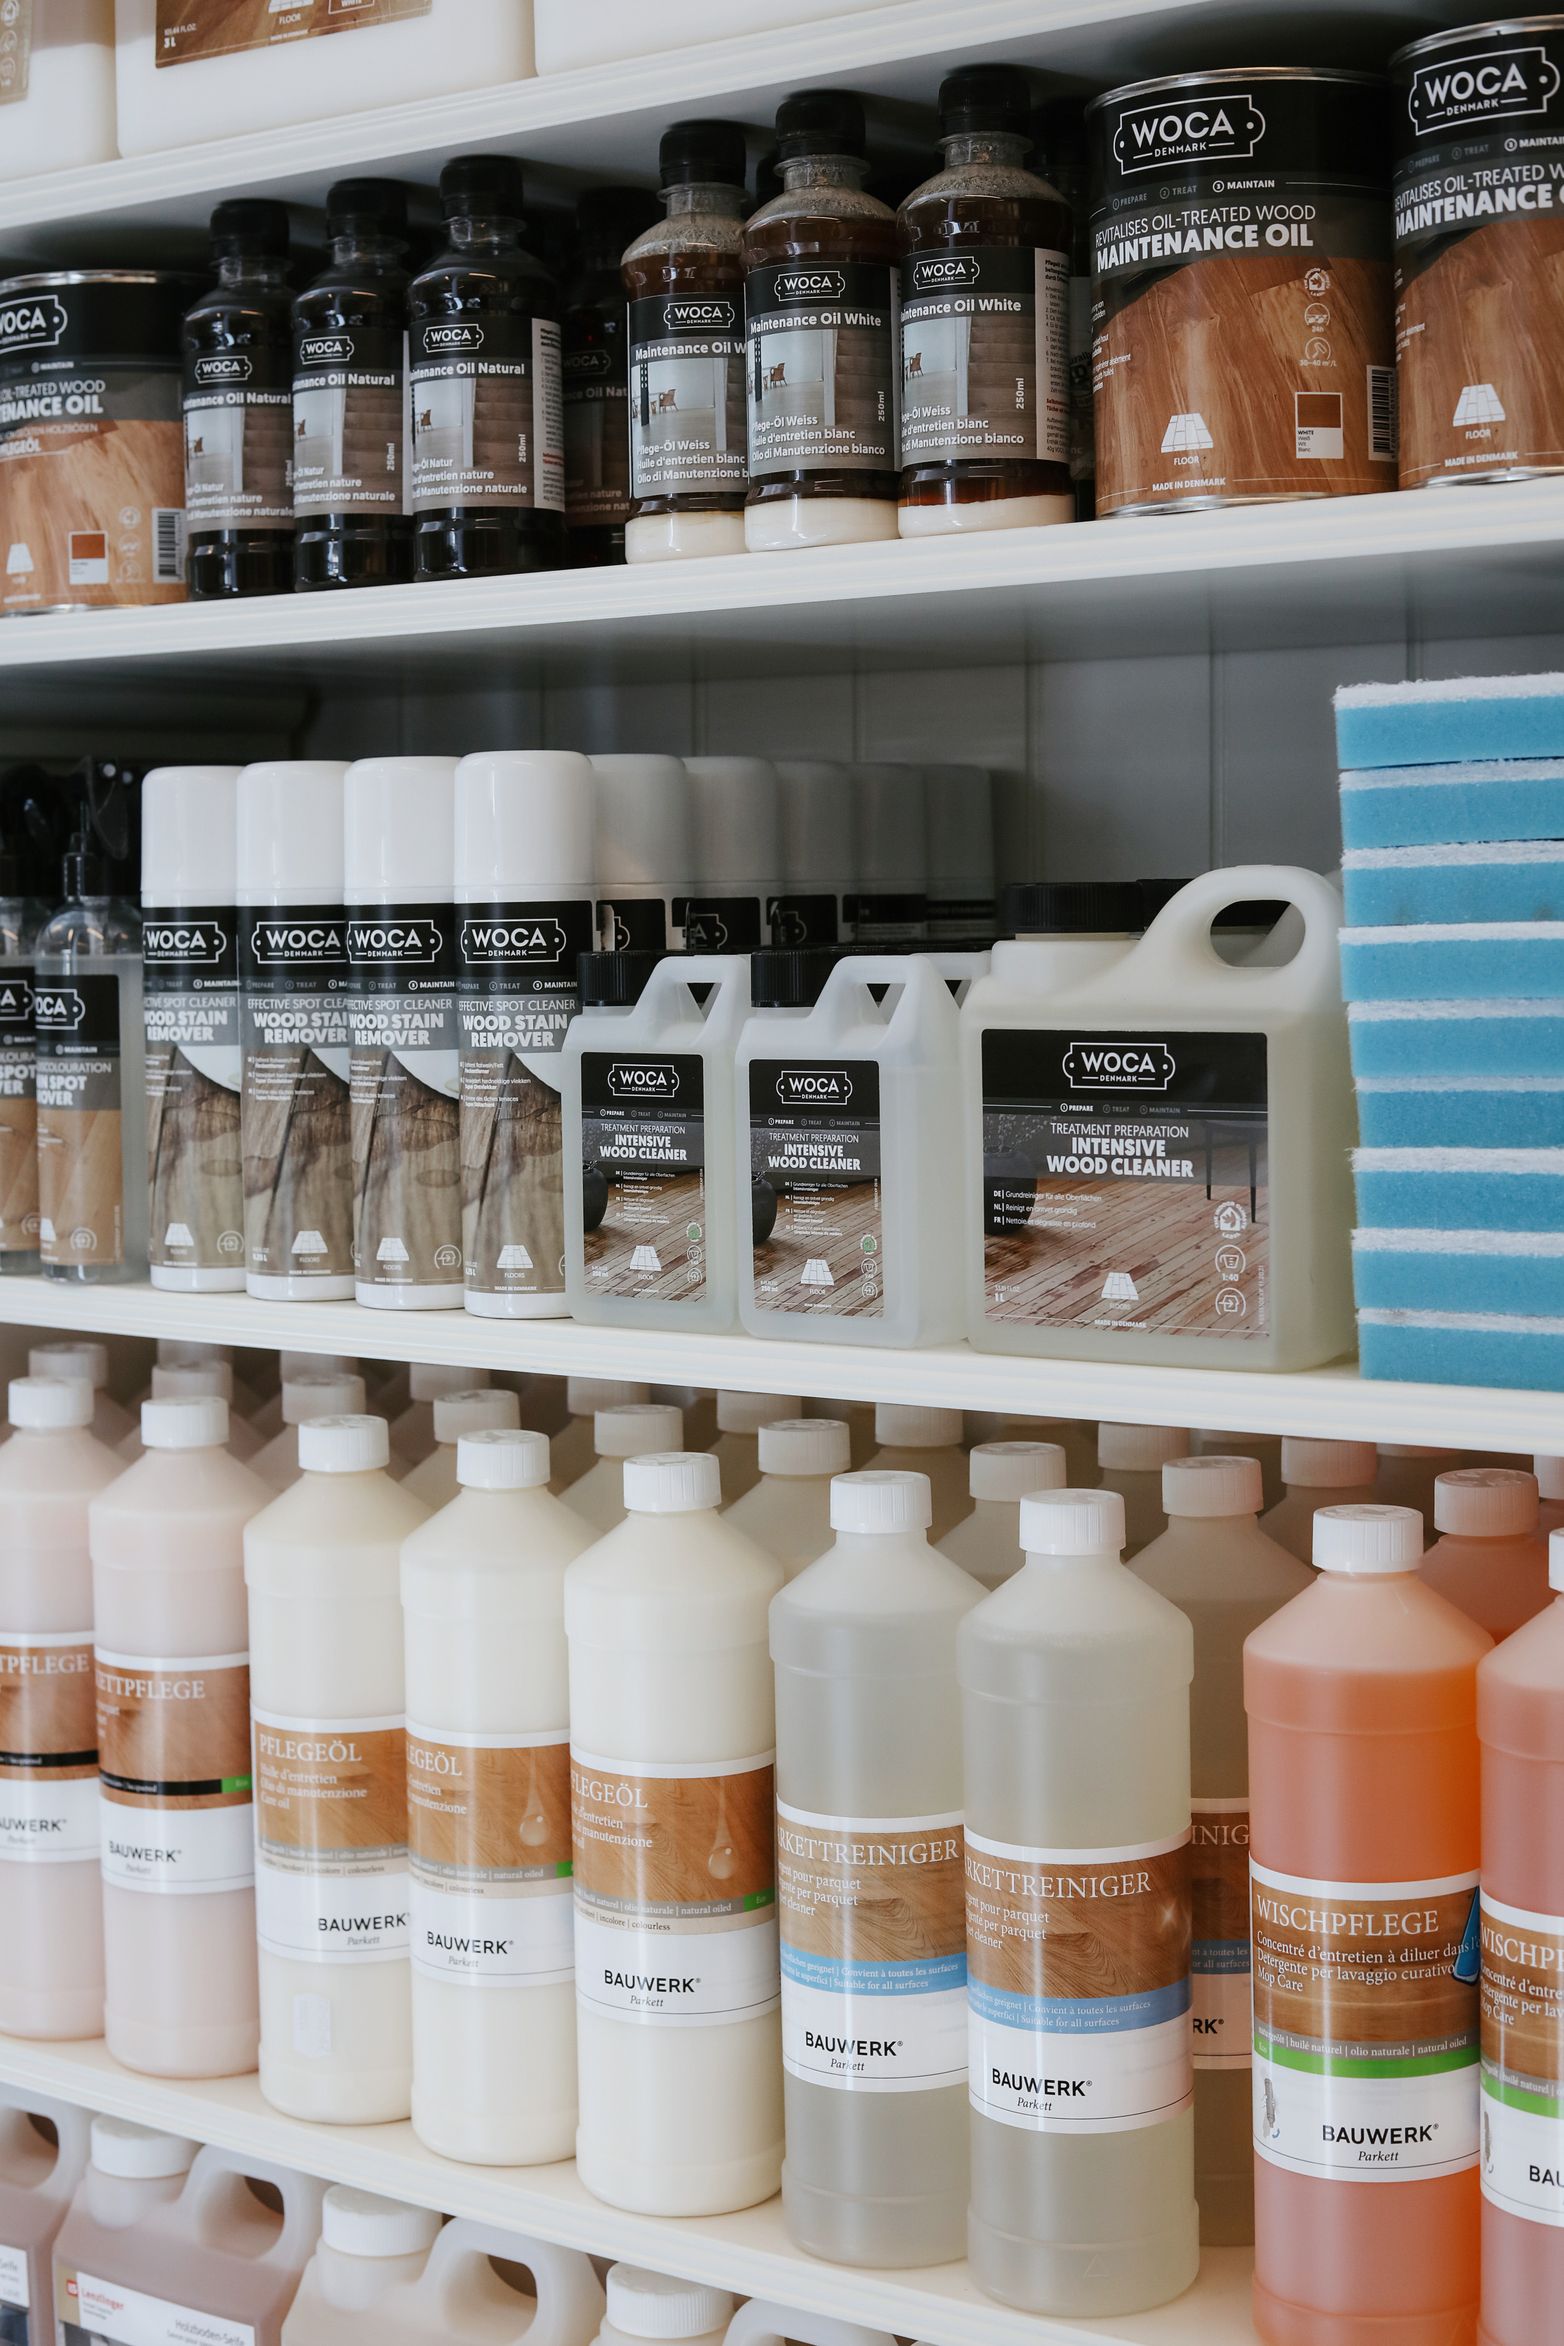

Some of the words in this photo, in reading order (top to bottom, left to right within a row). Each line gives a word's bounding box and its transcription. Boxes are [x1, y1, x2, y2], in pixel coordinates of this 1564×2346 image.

[1424, 62, 1528, 107] WOCA
[1446, 98, 1499, 116] DENMARK
[1131, 108, 1235, 148] WOCA
[1154, 142, 1207, 157] DENMARK
[1444, 164, 1545, 195] OIL-TREATED
[1172, 185, 1198, 196] TREAT
[1226, 180, 1275, 190] MAINTAIN
[1151, 206, 1251, 232] OIL-TREATED
[1255, 204, 1316, 221] WOOD
[1396, 183, 1554, 240] MAINTENANCE
[1097, 224, 1259, 274] MAINTENANCE
[1265, 223, 1314, 247] OIL
[922, 262, 966, 278] WOCA
[784, 276, 833, 291] WOCA
[675, 307, 723, 320] WOCA
[954, 299, 975, 313] Oil
[979, 299, 1022, 312] White
[750, 315, 817, 335] Maintenance
[820, 312, 841, 325] Oil
[845, 313, 882, 327] White
[431, 328, 471, 342] WOCA
[306, 341, 342, 354] WOCA
[635, 344, 709, 361] Maintenance
[711, 342, 731, 354] Oil
[202, 360, 240, 374] WOCA
[456, 363, 475, 374] Oil
[478, 363, 525, 375] Natural
[59, 380, 106, 395] WOOD
[328, 373, 346, 386] Oil
[348, 373, 395, 387] Natural
[226, 392, 244, 405] Oil
[247, 393, 292, 405] Natural
[1016, 377, 1025, 410] 250ml
[65, 394, 104, 415] OIL
[877, 391, 886, 422] 250ml
[922, 406, 951, 417] Weiss
[787, 414, 819, 426] Weiss
[956, 419, 989, 429] blanc
[824, 427, 855, 439] blanc
[984, 432, 1024, 445] bianco
[1465, 429, 1491, 440] FLOOR
[518, 434, 527, 463] 250ml
[678, 440, 711, 451] Weiss
[773, 441, 850, 458] Manutenzione
[852, 440, 886, 455] bianco
[387, 442, 395, 471] 250ml
[656, 455, 714, 467] d'entretien
[716, 452, 746, 463] blanc
[1173, 456, 1200, 466] FLOOR
[460, 470, 495, 481] nature
[664, 468, 741, 482] Manutenzione
[485, 483, 528, 495] naturale
[1152, 483, 1174, 492] MADE
[1184, 477, 1226, 490] DENMARK
[147, 930, 207, 949] WOCA
[266, 929, 341, 948] WOCA
[354, 928, 422, 948] WOCA
[472, 928, 547, 947] WOCA
[189, 997, 236, 1009] CLEANER
[294, 999, 320, 1010] SPOT
[375, 1000, 400, 1011] SPOT
[404, 999, 452, 1011] CLEANER
[497, 1000, 525, 1011] SPOT
[528, 1000, 576, 1011] CLEANER
[179, 1011, 228, 1026] STAIN
[253, 1013, 307, 1028] WOOD
[350, 1014, 389, 1030] WOOD
[392, 1013, 444, 1029] STAIN
[463, 1015, 511, 1031] WOOD
[515, 1014, 568, 1030] STAIN
[147, 1026, 214, 1042] REMOVER
[264, 1028, 348, 1043] REMOVER
[355, 1030, 430, 1046] REMOVER
[472, 1031, 555, 1048] REMOVER
[1081, 1051, 1156, 1074] WOCA
[620, 1070, 668, 1086] WOCA
[789, 1077, 840, 1093] WOCA
[1100, 1075, 1138, 1083] DENMARK
[1068, 1104, 1094, 1113] PREPARE
[601, 1122, 639, 1133] TREATMENT
[640, 1125, 686, 1135] PREPARATION
[1050, 1122, 1112, 1137] TREATMENT
[1114, 1124, 1189, 1139] PREPARATION
[615, 1134, 671, 1148] INTENSIVE
[769, 1132, 810, 1142] TREATMENT
[811, 1133, 859, 1144] PREPARATION
[600, 1145, 637, 1159] WOOD
[639, 1147, 688, 1161] CLEANER
[784, 1143, 844, 1157] INTENSIVE
[1071, 1137, 1166, 1158] INTENSIVE
[768, 1155, 807, 1169] WOOD
[809, 1157, 861, 1171] CLEANER
[1046, 1155, 1108, 1175] WOOD
[1111, 1159, 1195, 1178] CLEANER
[259, 1733, 362, 1762] PFLEGEÖL
[494, 1869, 523, 1880] natural
[525, 1868, 544, 1879] oiled
[816, 1875, 861, 1891] parquet
[814, 1891, 858, 1908] parquet
[681, 1905, 710, 1915] natural
[712, 1903, 732, 1913] oiled
[980, 1901, 1001, 1915] pour
[1003, 1907, 1049, 1925] parquet
[1256, 1894, 1439, 1936] WISCHPFLEGE
[632, 1918, 671, 1931] colourless
[1001, 1924, 1046, 1941] parquet
[1257, 1931, 1304, 1957] Concentré
[1387, 1950, 1395, 1963] à
[1400, 1946, 1440, 1964] diluer
[1443, 1942, 1469, 1957] dans
[888, 1966, 914, 1977] toutes
[928, 1962, 960, 1974] surfaces
[1257, 1948, 1308, 1976] Detergente
[1311, 1964, 1332, 1981] per
[1337, 1964, 1397, 1985] lavaggio
[1401, 1963, 1455, 1981] curativo
[895, 1978, 929, 1989] surfaces
[1257, 1964, 1275, 1988] Mop
[1277, 1973, 1303, 1992] Care
[1076, 2003, 1104, 2015] toutes
[1105, 2003, 1117, 2014] les
[1118, 1999, 1151, 2012] surfaces
[1493, 2004, 1515, 2026] Care
[1521, 2001, 1542, 2016] per
[1085, 2015, 1120, 2027] surfaces
[1290, 2037, 1310, 2050] huilé
[1312, 2043, 1343, 2055] naturel
[1350, 2045, 1369, 2056] olio
[1371, 2045, 1410, 2057] naturale
[1417, 2040, 1448, 2054] natural
[1449, 2036, 1467, 2050] oiled
[831, 2057, 865, 2072] Parkett
[1520, 2078, 1549, 2094] naturel
[1017, 2096, 1052, 2112] Parkett
[1358, 2150, 1399, 2163] Parkett
